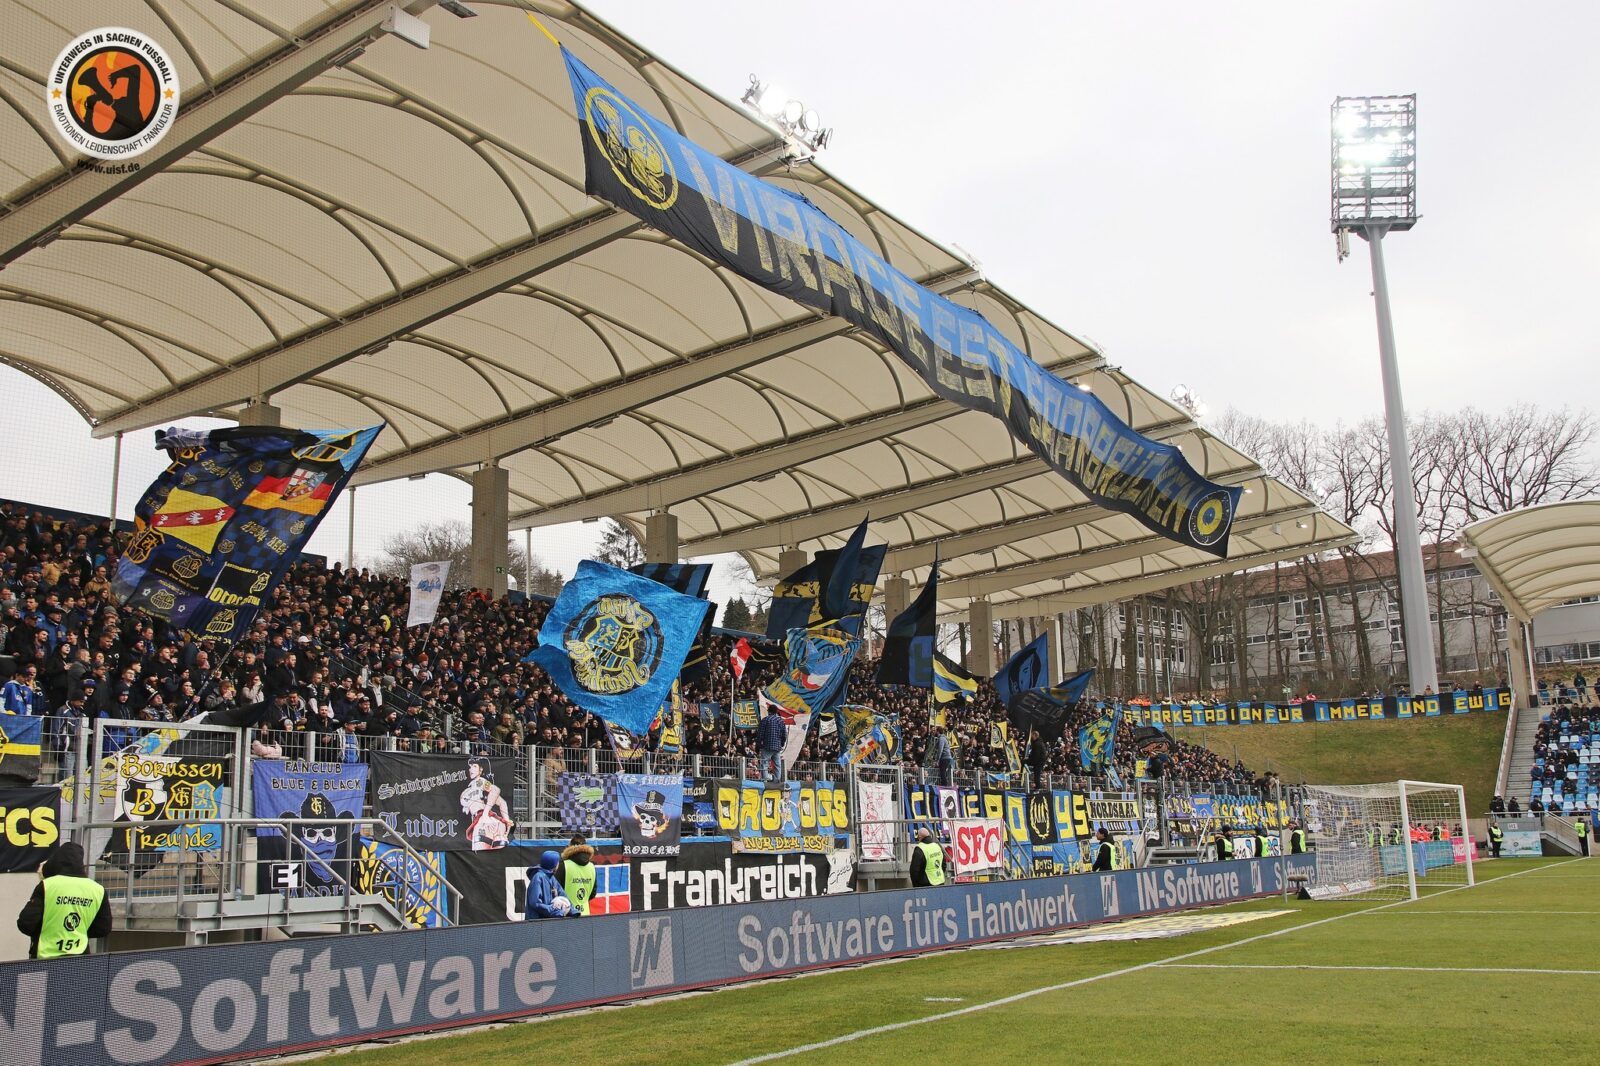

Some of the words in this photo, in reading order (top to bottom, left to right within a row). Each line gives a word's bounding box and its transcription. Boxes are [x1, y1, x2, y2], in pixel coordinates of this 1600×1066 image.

[680, 143, 931, 371] VIRAGE
[931, 299, 1016, 418] EST
[1123, 708, 1263, 724] GSPARKSTADION
[1265, 707, 1303, 722] FÜR
[1319, 703, 1384, 719] IMMER
[1400, 700, 1440, 715] UND
[1455, 692, 1511, 711] EWIG
[120, 753, 223, 780] Borussen
[284, 761, 343, 774] FANCLUB
[272, 778, 306, 790] BLUE
[323, 779, 362, 791] BLACK
[377, 770, 468, 801] Stadtgraben
[1089, 802, 1137, 819] NORDSAAR
[378, 811, 459, 838] Luder
[743, 836, 774, 851] NUR
[956, 825, 1000, 866] SFC
[272, 864, 303, 888] E1
[639, 853, 818, 911] Frankreich
[1136, 866, 1240, 911] IN-Software
[55, 896, 94, 908] SICHERHEIT
[737, 910, 895, 973] Software
[902, 897, 959, 948] fürs
[965, 884, 1078, 939] Handwerk
[55, 938, 81, 951] 151
[0, 947, 558, 1066] N-Software
